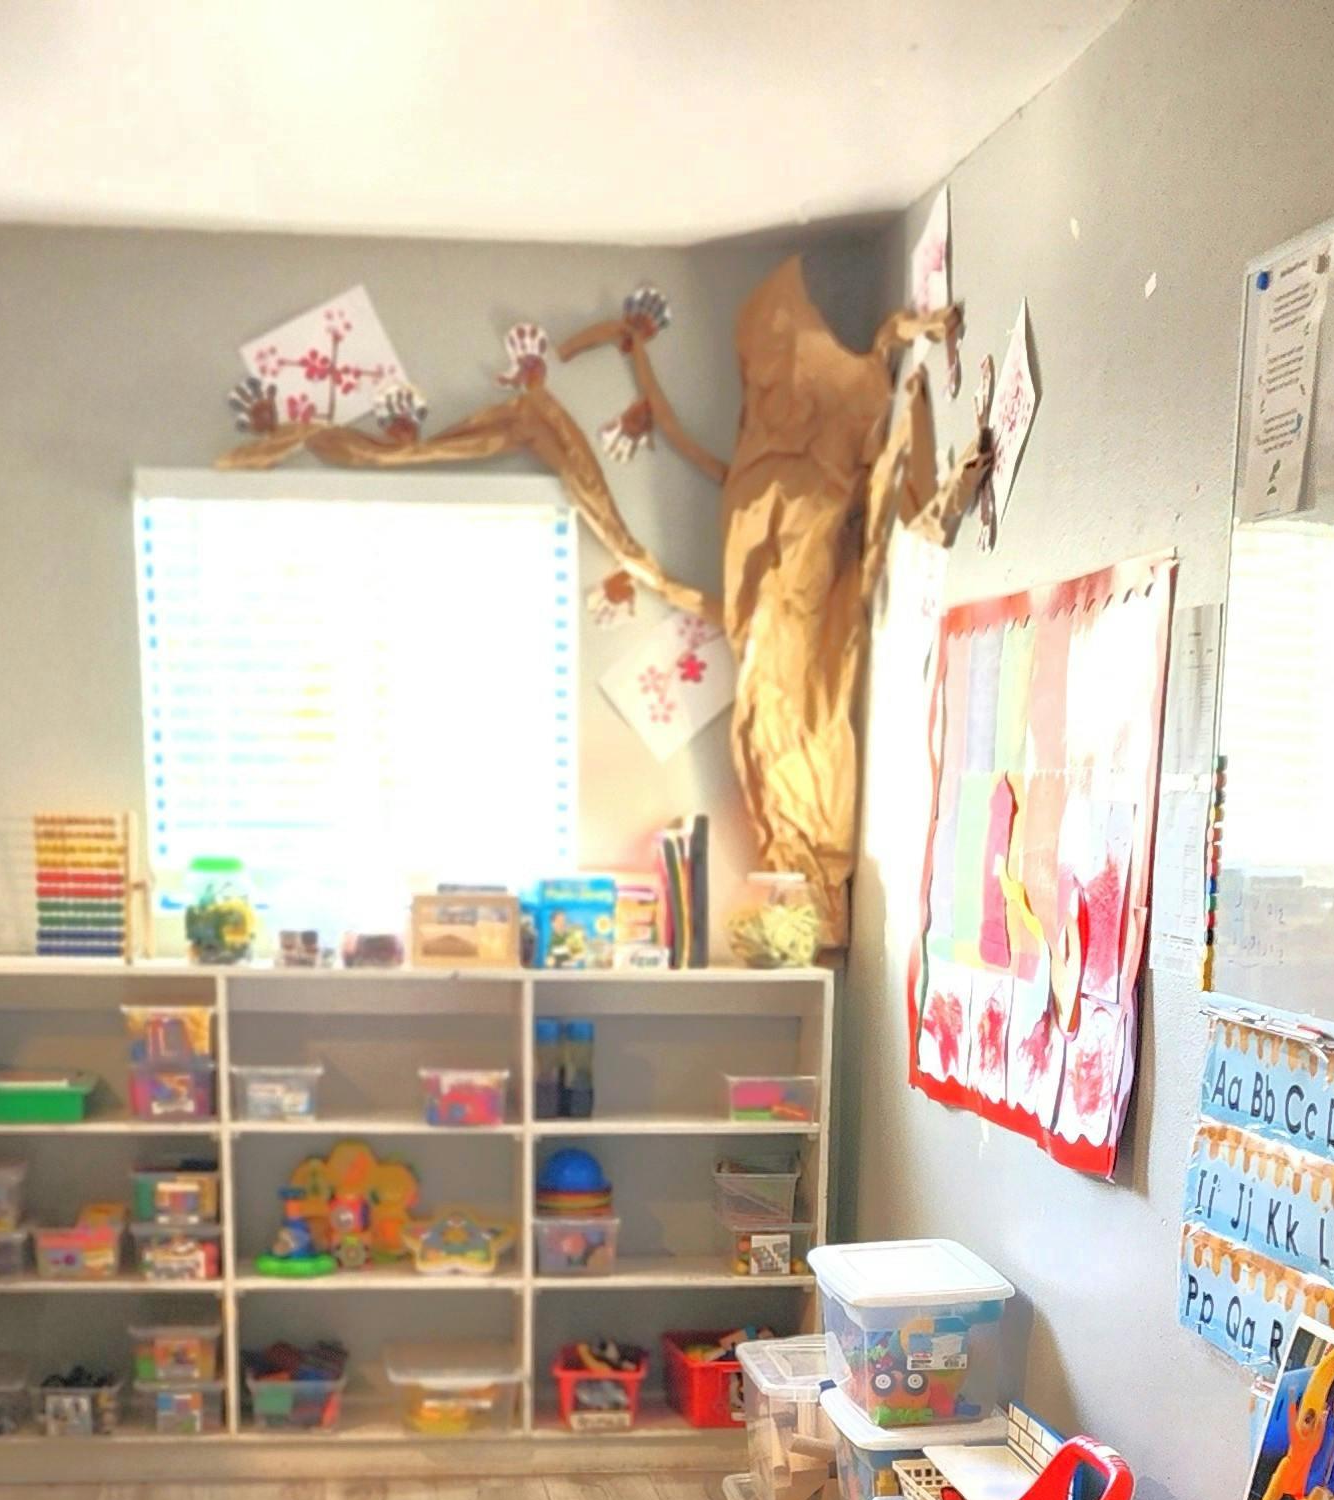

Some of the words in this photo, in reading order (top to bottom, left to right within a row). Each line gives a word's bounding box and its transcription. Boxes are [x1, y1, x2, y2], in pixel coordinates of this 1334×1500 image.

[1212, 1060, 1242, 1111] Aa
[1249, 1072, 1275, 1120] Bb
[1284, 1084, 1318, 1140] Cc
[1230, 1182, 1254, 1243] Jj
[1266, 1197, 1300, 1257] Kk
[1186, 1274, 1214, 1335] Pp
